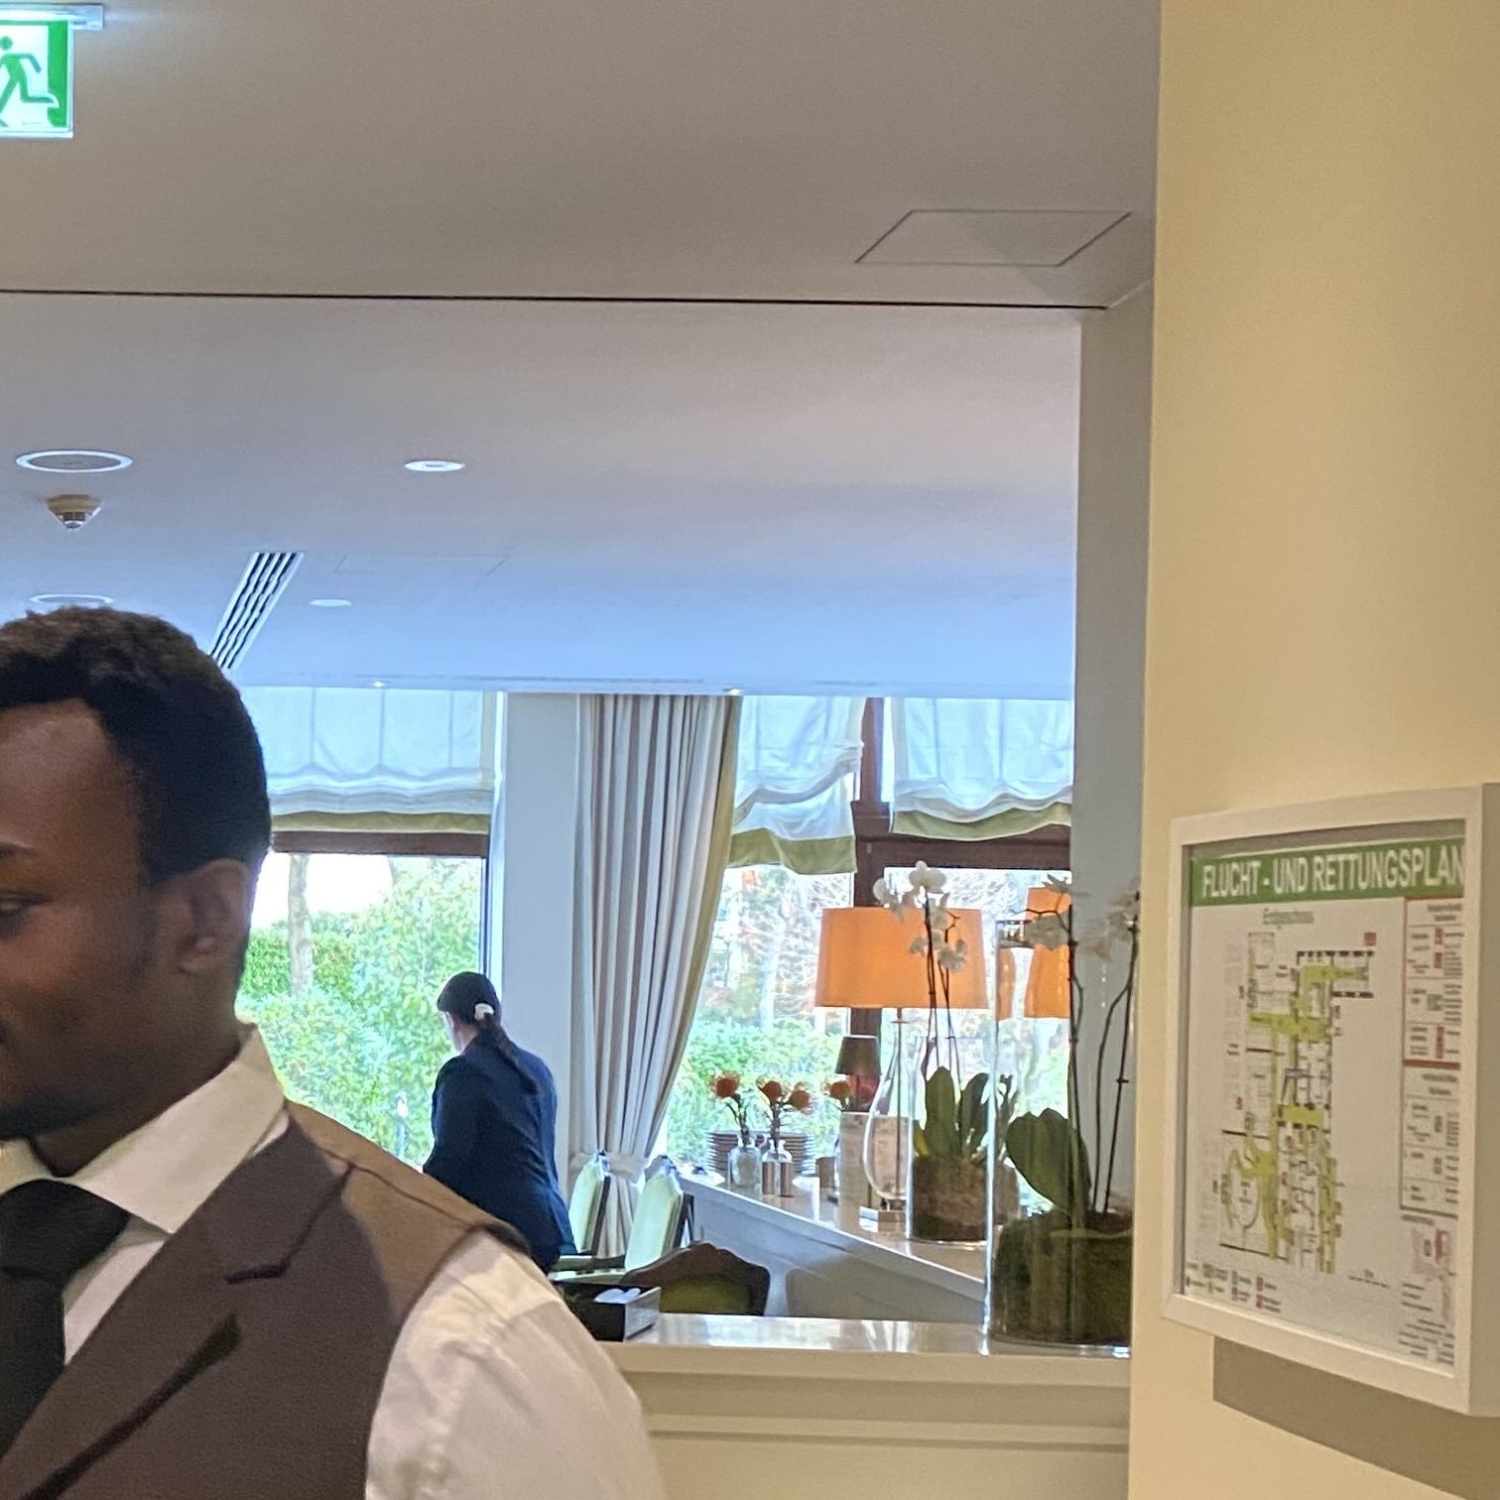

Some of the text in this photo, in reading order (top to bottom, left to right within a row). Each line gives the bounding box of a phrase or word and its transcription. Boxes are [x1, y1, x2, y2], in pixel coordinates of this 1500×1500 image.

[1202, 860, 1261, 897] FLUCHT
[1273, 857, 1308, 895] UND
[1313, 845, 1465, 892] RETTUNGSPLAN
